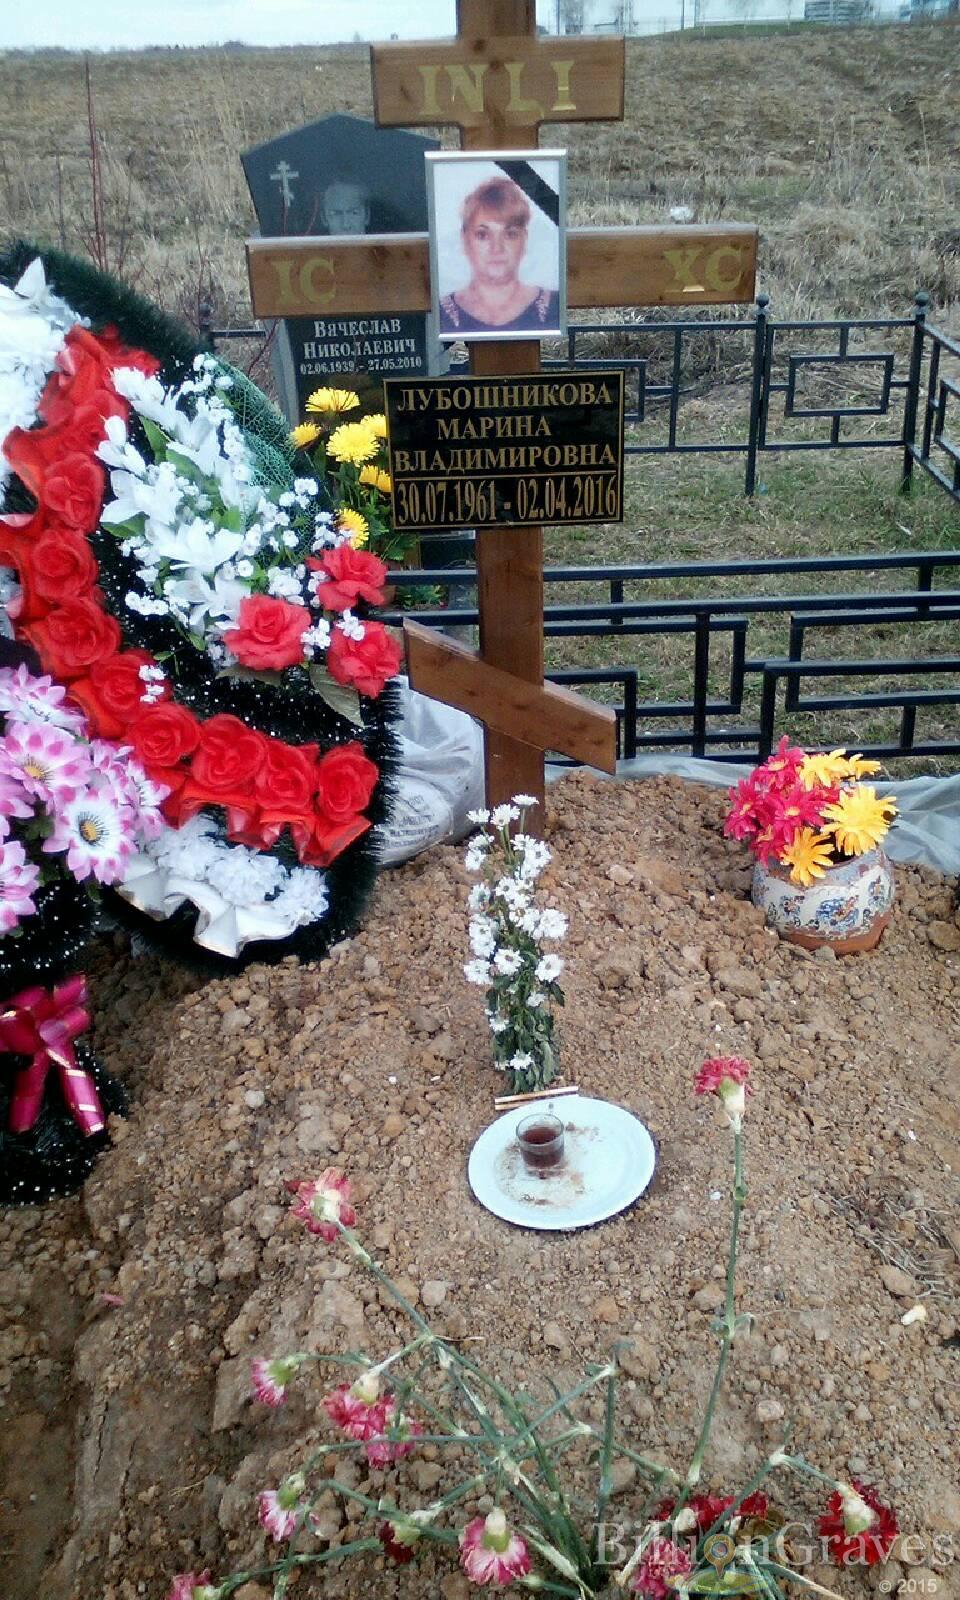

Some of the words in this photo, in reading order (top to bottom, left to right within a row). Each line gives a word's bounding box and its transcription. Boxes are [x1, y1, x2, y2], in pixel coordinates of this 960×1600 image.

[304, 338, 416, 360] НИКОЛАЕВИЧ
[367, 356, 422, 371] 27.05.2010
[397, 381, 613, 411] ЛУБОШНИКОВА
[437, 415, 552, 440] МАРИНА
[394, 443, 616, 475] ВЛАДИМИРОВНА
[397, 479, 497, 524] 30.07.1961
[517, 475, 617, 520] 02.04.2016
